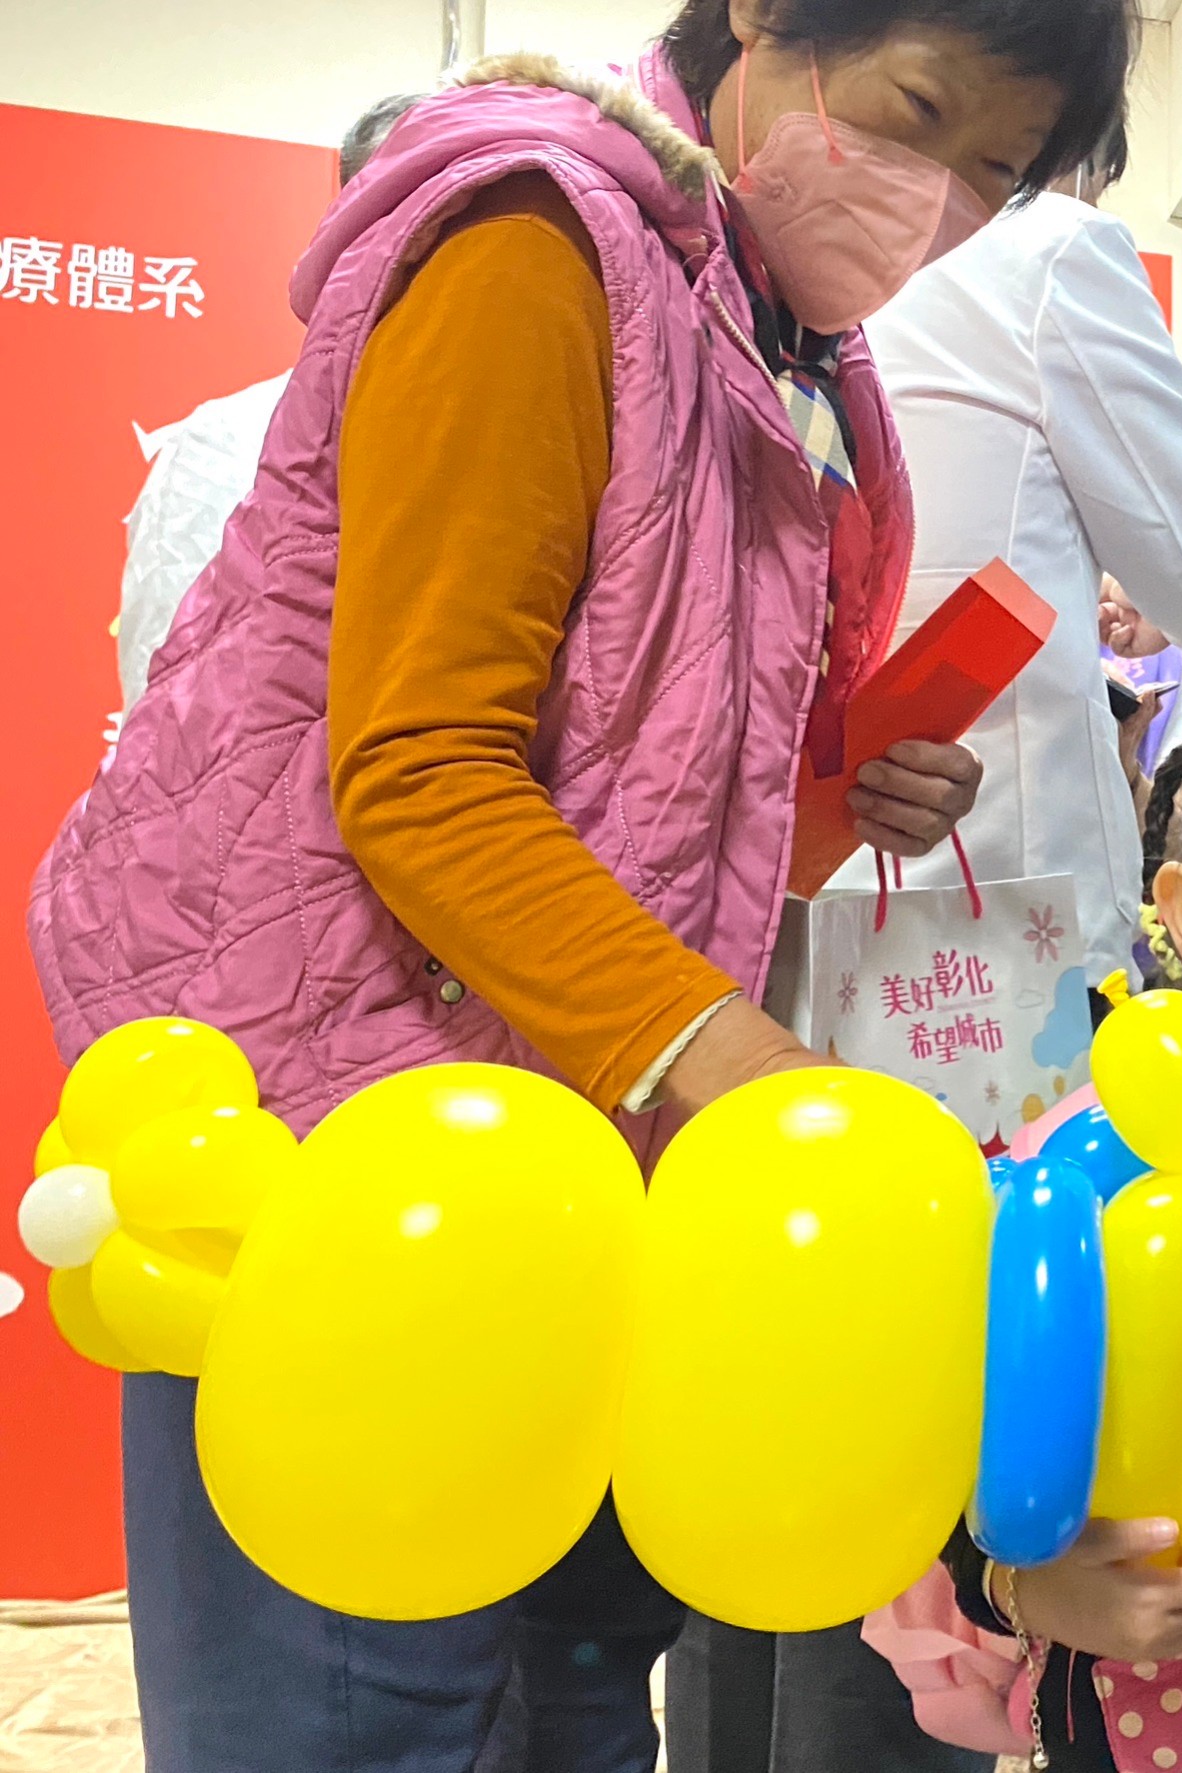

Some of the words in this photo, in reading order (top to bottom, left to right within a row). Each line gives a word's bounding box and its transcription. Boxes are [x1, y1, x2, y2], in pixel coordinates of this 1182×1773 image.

[0, 236, 205, 318] 療體系
[880, 949, 994, 1018] 美好彰化
[907, 1012, 1003, 1065] 希望城市
